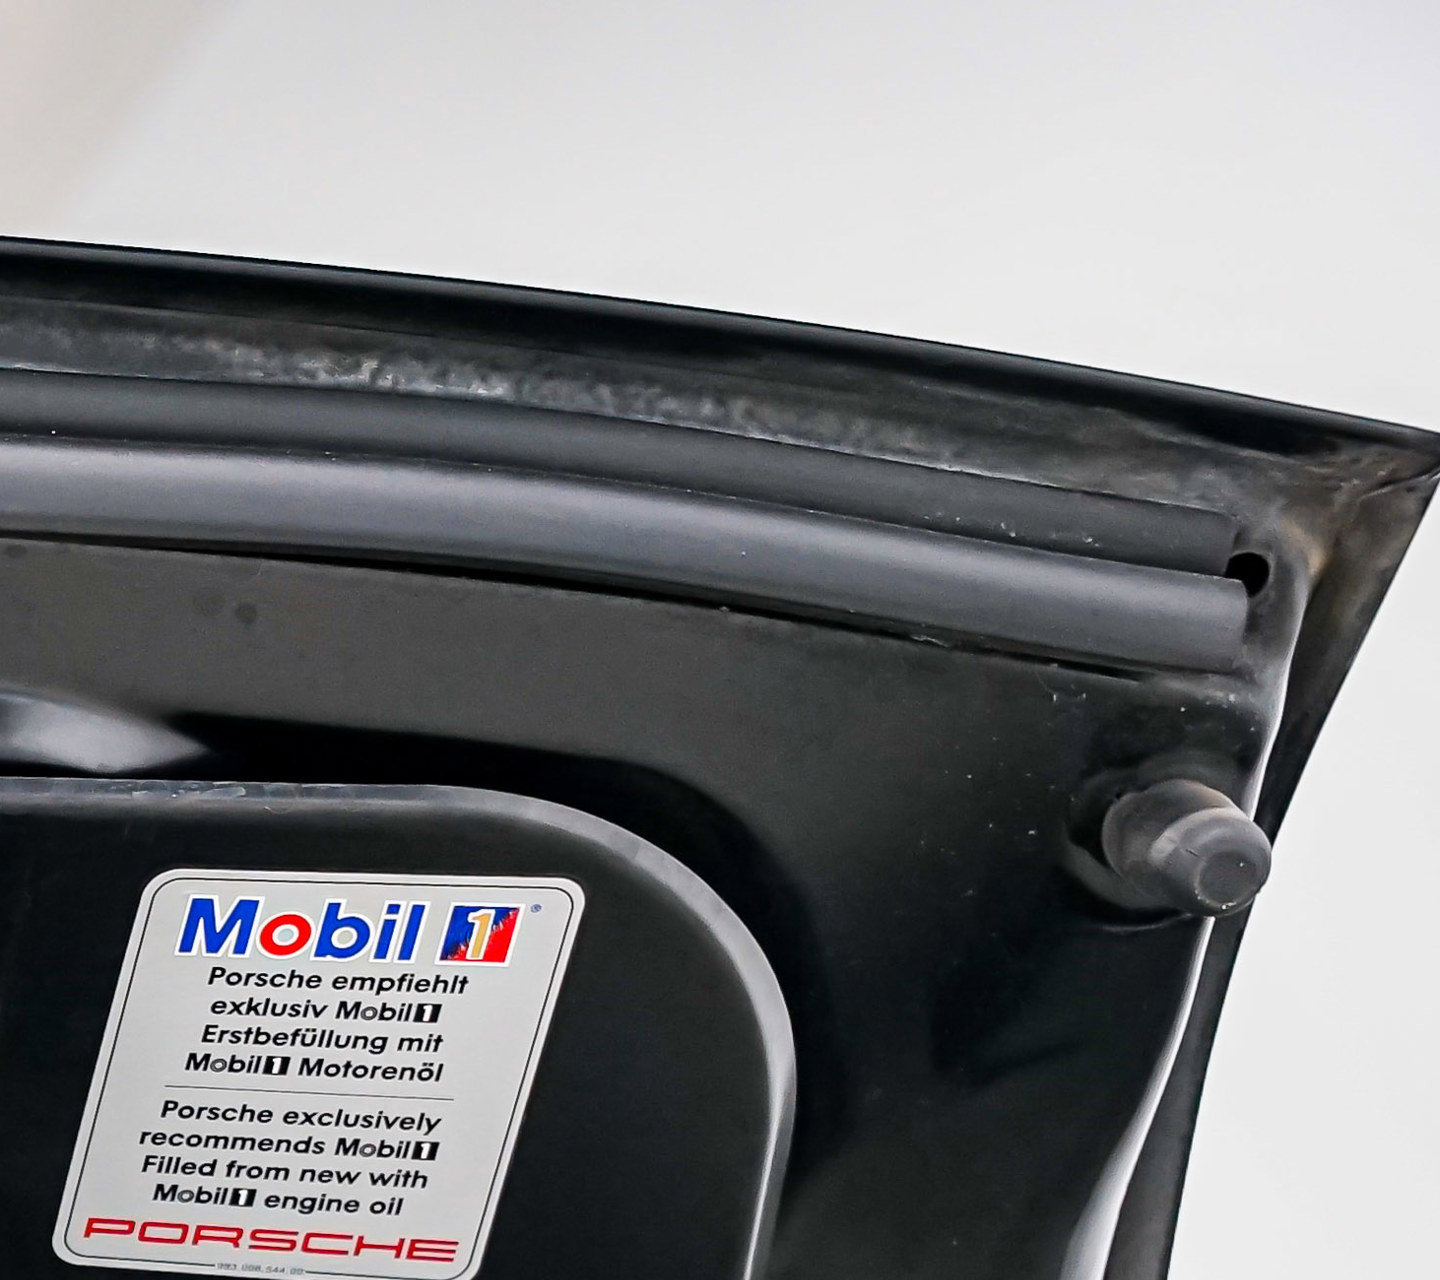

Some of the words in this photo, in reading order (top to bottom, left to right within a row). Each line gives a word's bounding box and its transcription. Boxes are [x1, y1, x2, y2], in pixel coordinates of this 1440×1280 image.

[174, 893, 430, 964] Mobil
[208, 967, 322, 989] Porsche
[331, 972, 468, 996] empfiehlt
[211, 999, 328, 1018] exklusiv
[201, 1024, 387, 1054] Erstbefüllung
[397, 1033, 443, 1053] mit
[297, 1058, 443, 1082] Motorenöl
[159, 1100, 273, 1123] Porsche
[282, 1107, 441, 1135] exclusively
[139, 1131, 325, 1155] recommends
[141, 1155, 216, 1177] Filled
[225, 1159, 290, 1181] from
[299, 1168, 360, 1185] new
[369, 1168, 428, 1189] with
[264, 1194, 360, 1215] engine
[369, 1198, 404, 1216] oil
[83, 1217, 459, 1262] PORSCHE
